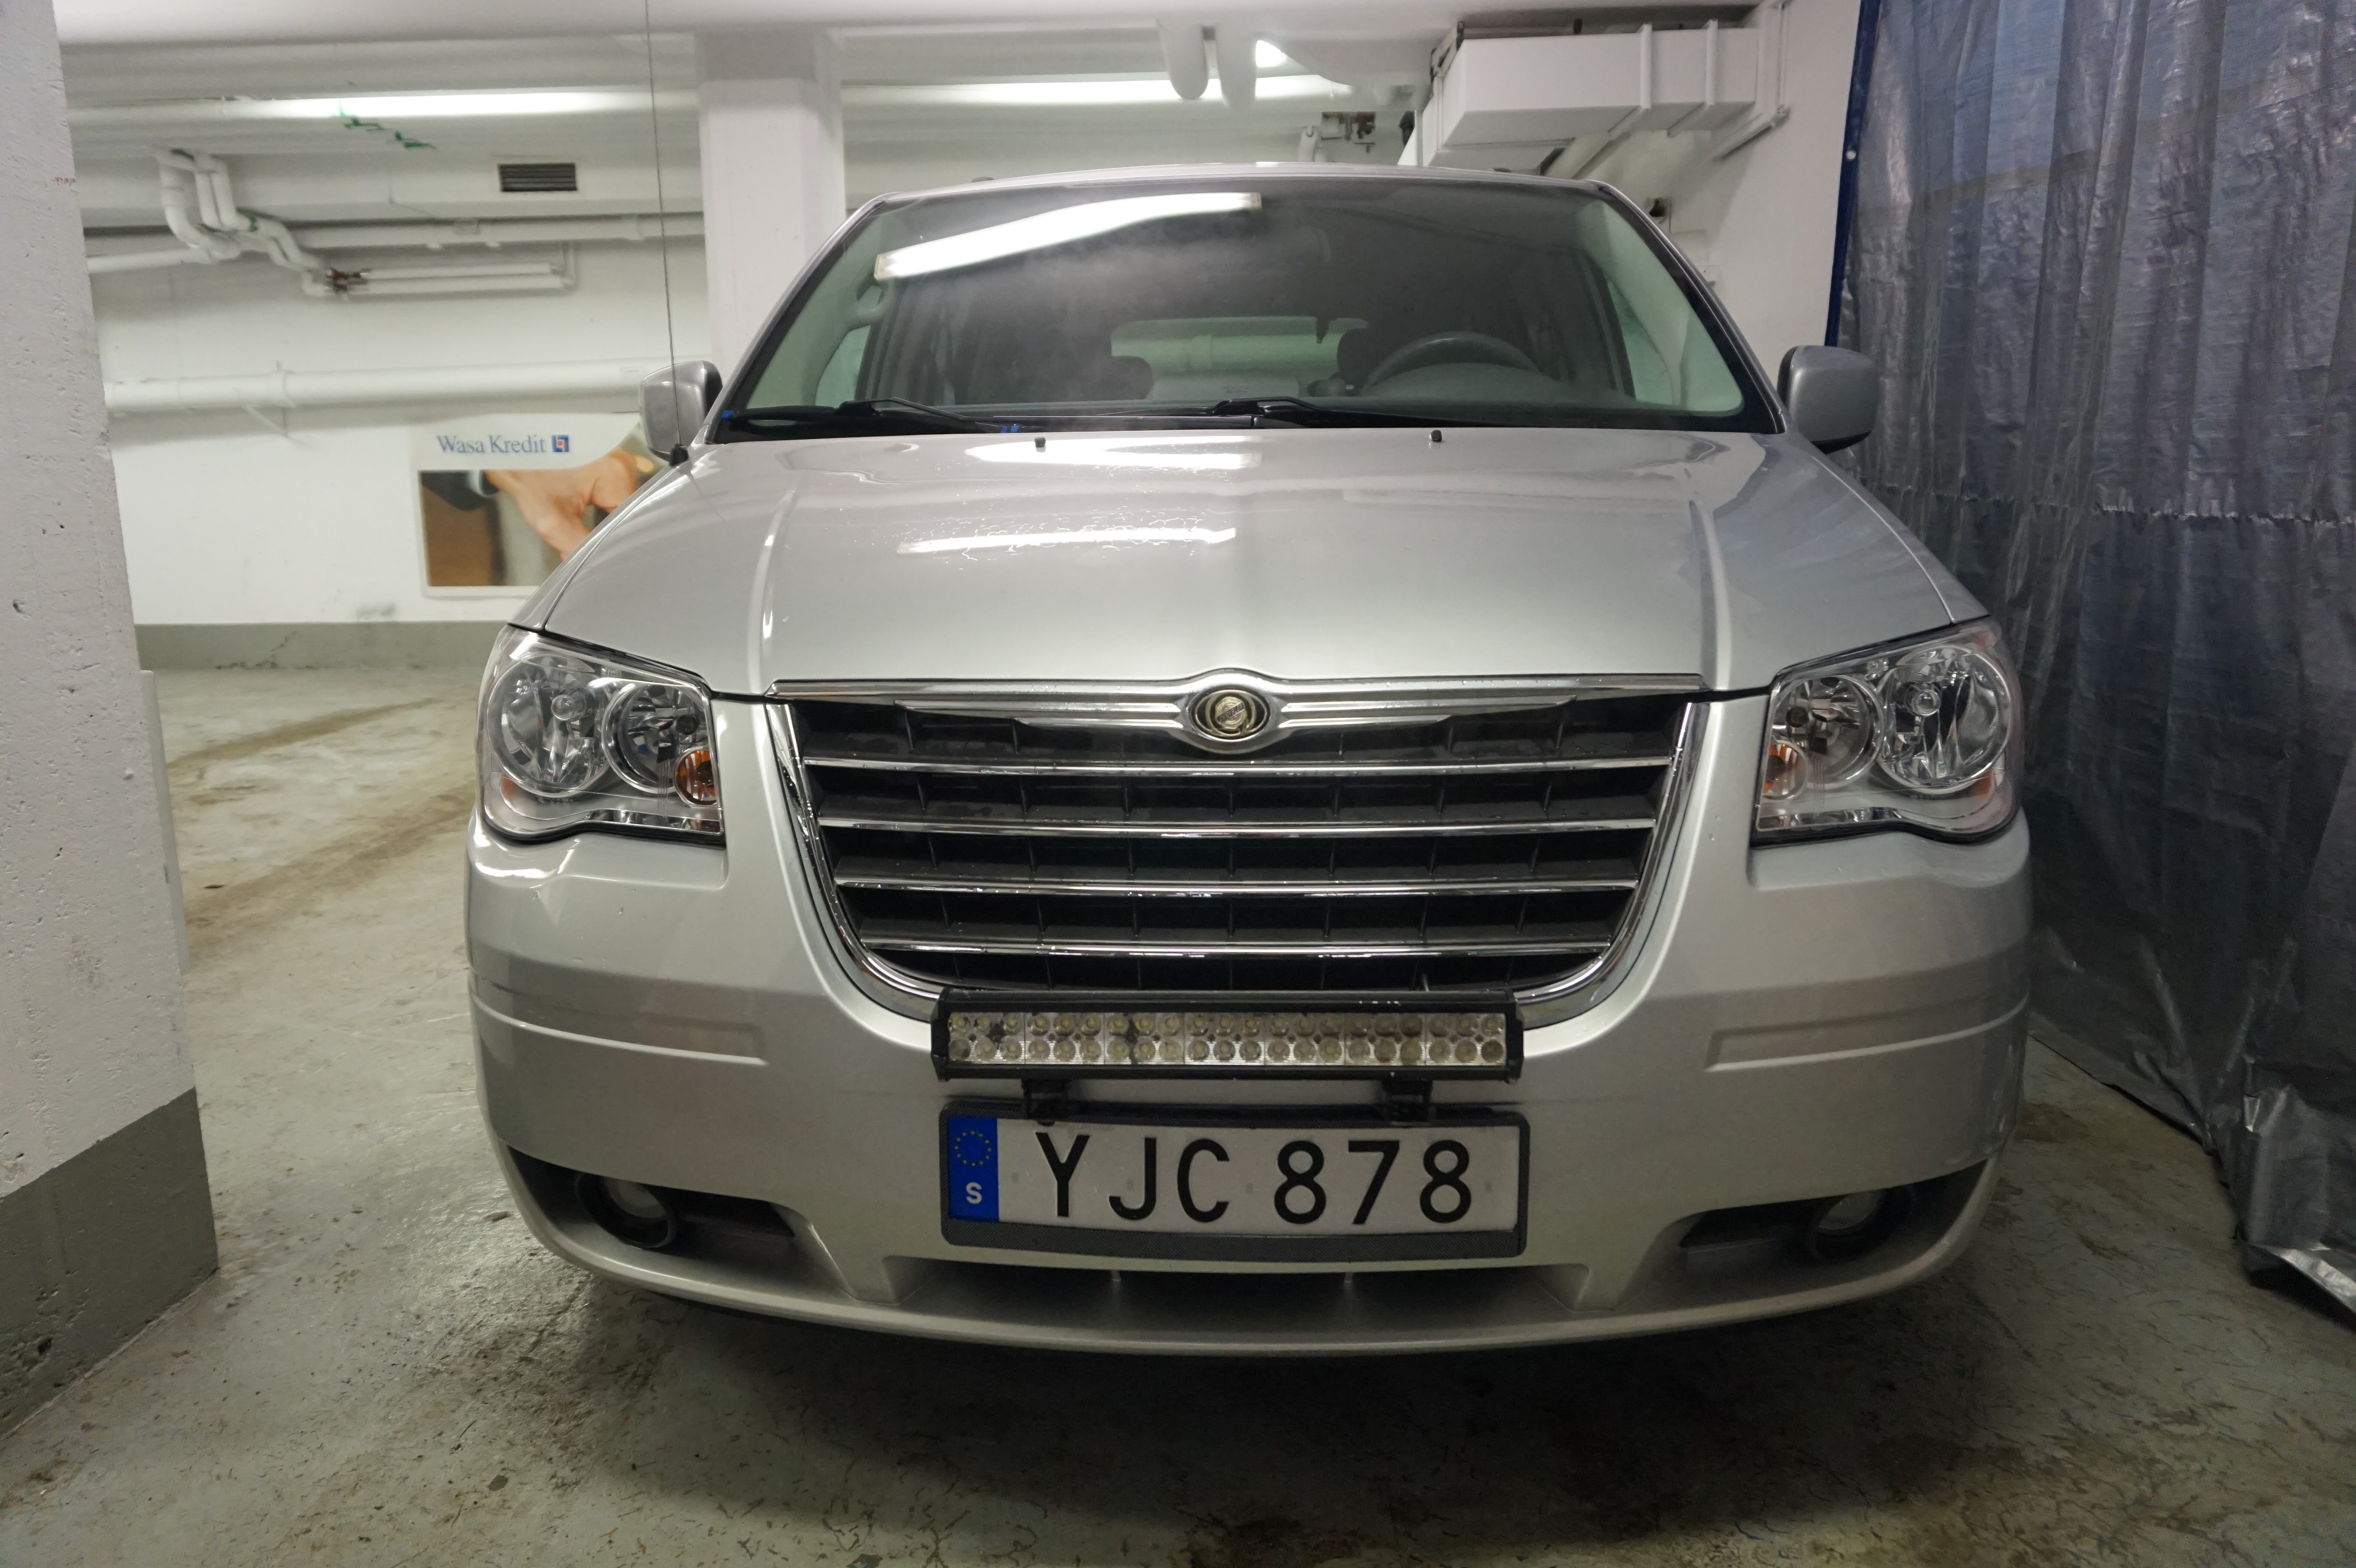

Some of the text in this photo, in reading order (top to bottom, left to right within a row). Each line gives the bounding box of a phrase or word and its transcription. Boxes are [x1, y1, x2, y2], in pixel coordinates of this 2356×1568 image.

[436, 434, 546, 453] Wasa Kredit
[1035, 1132, 1472, 1226] YJC 878
[966, 1182, 983, 1205] S
